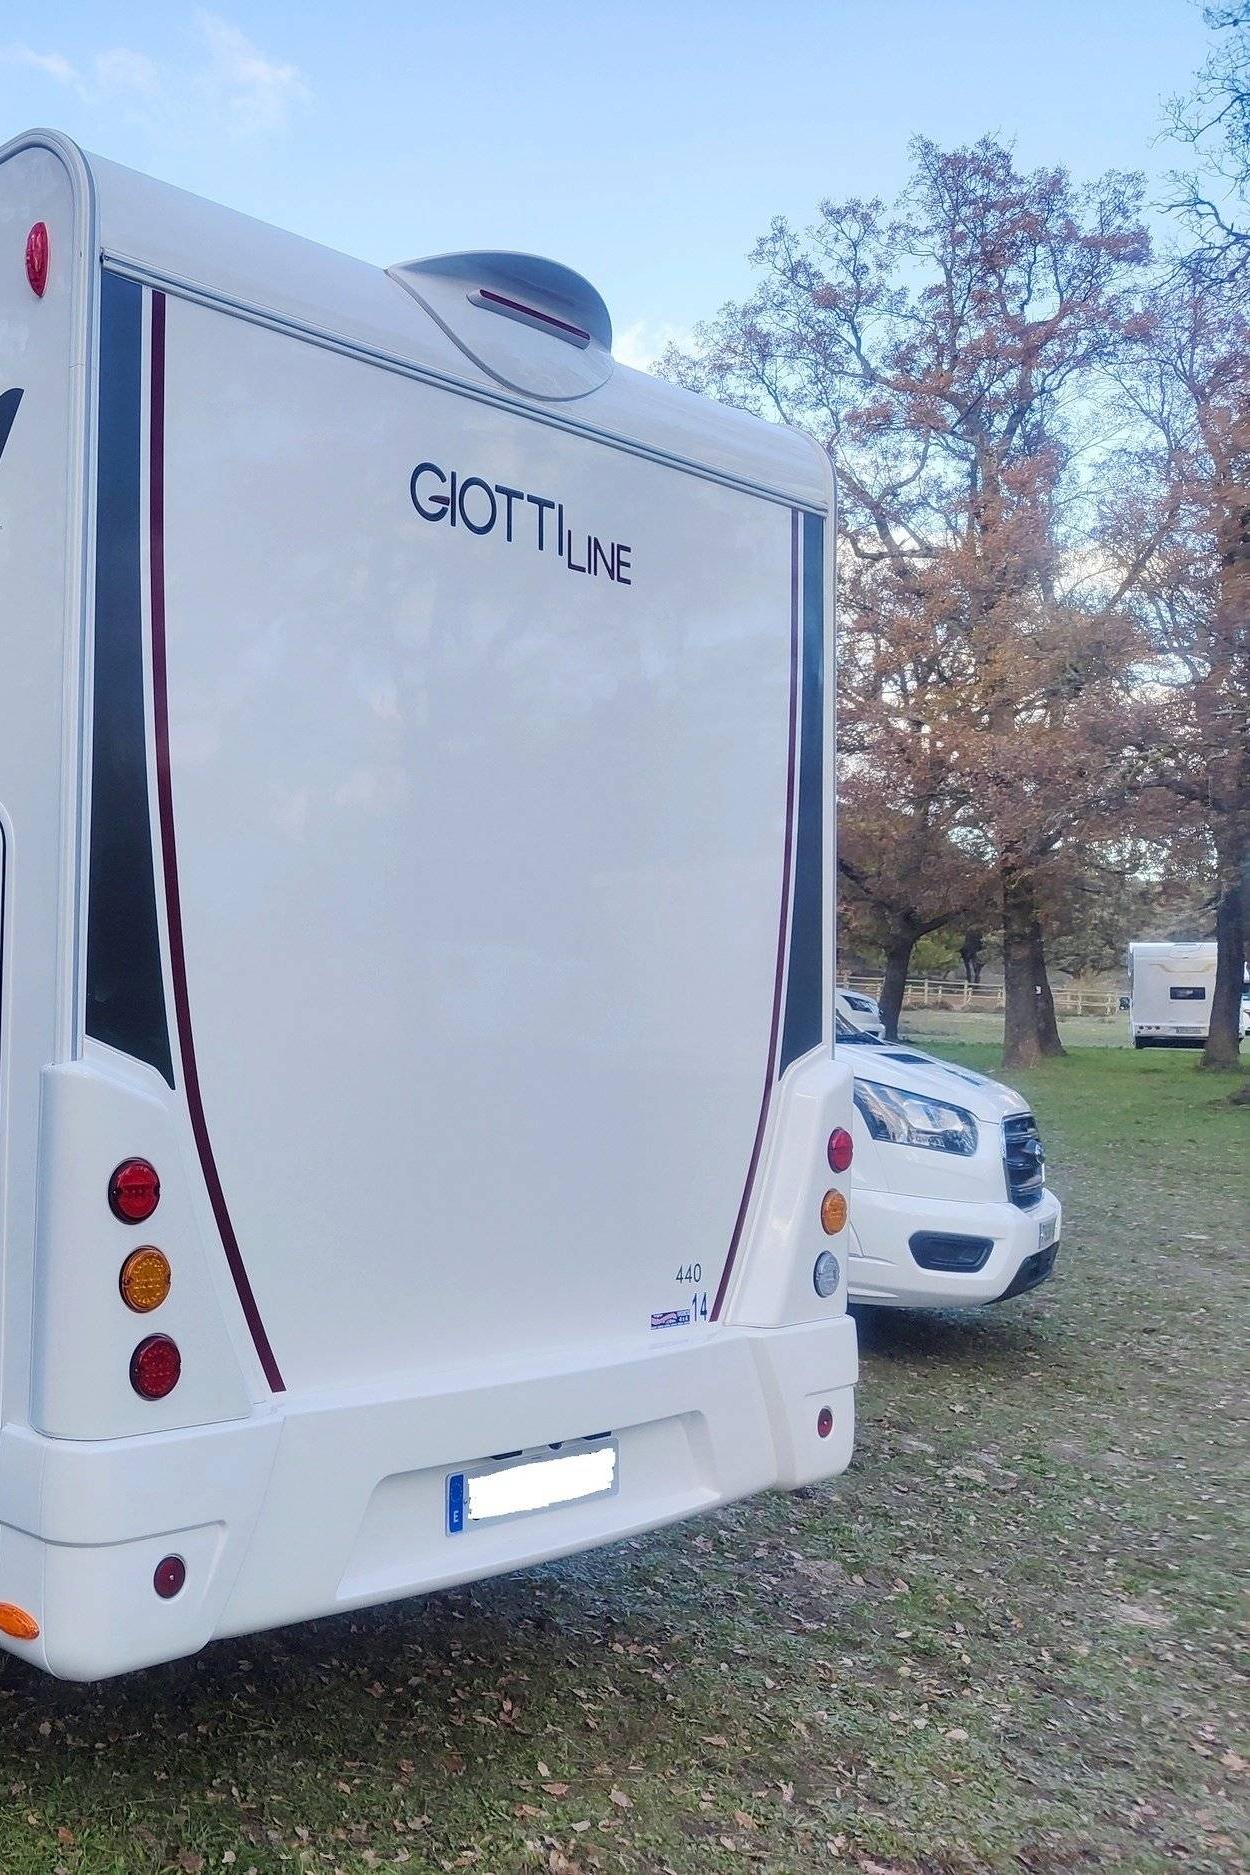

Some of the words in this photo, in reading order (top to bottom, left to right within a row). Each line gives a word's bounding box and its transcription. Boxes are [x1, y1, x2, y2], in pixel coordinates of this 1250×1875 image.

[675, 1263, 702, 1284] 440
[691, 1291, 708, 1322] 14
[453, 1510, 460, 1523] E
